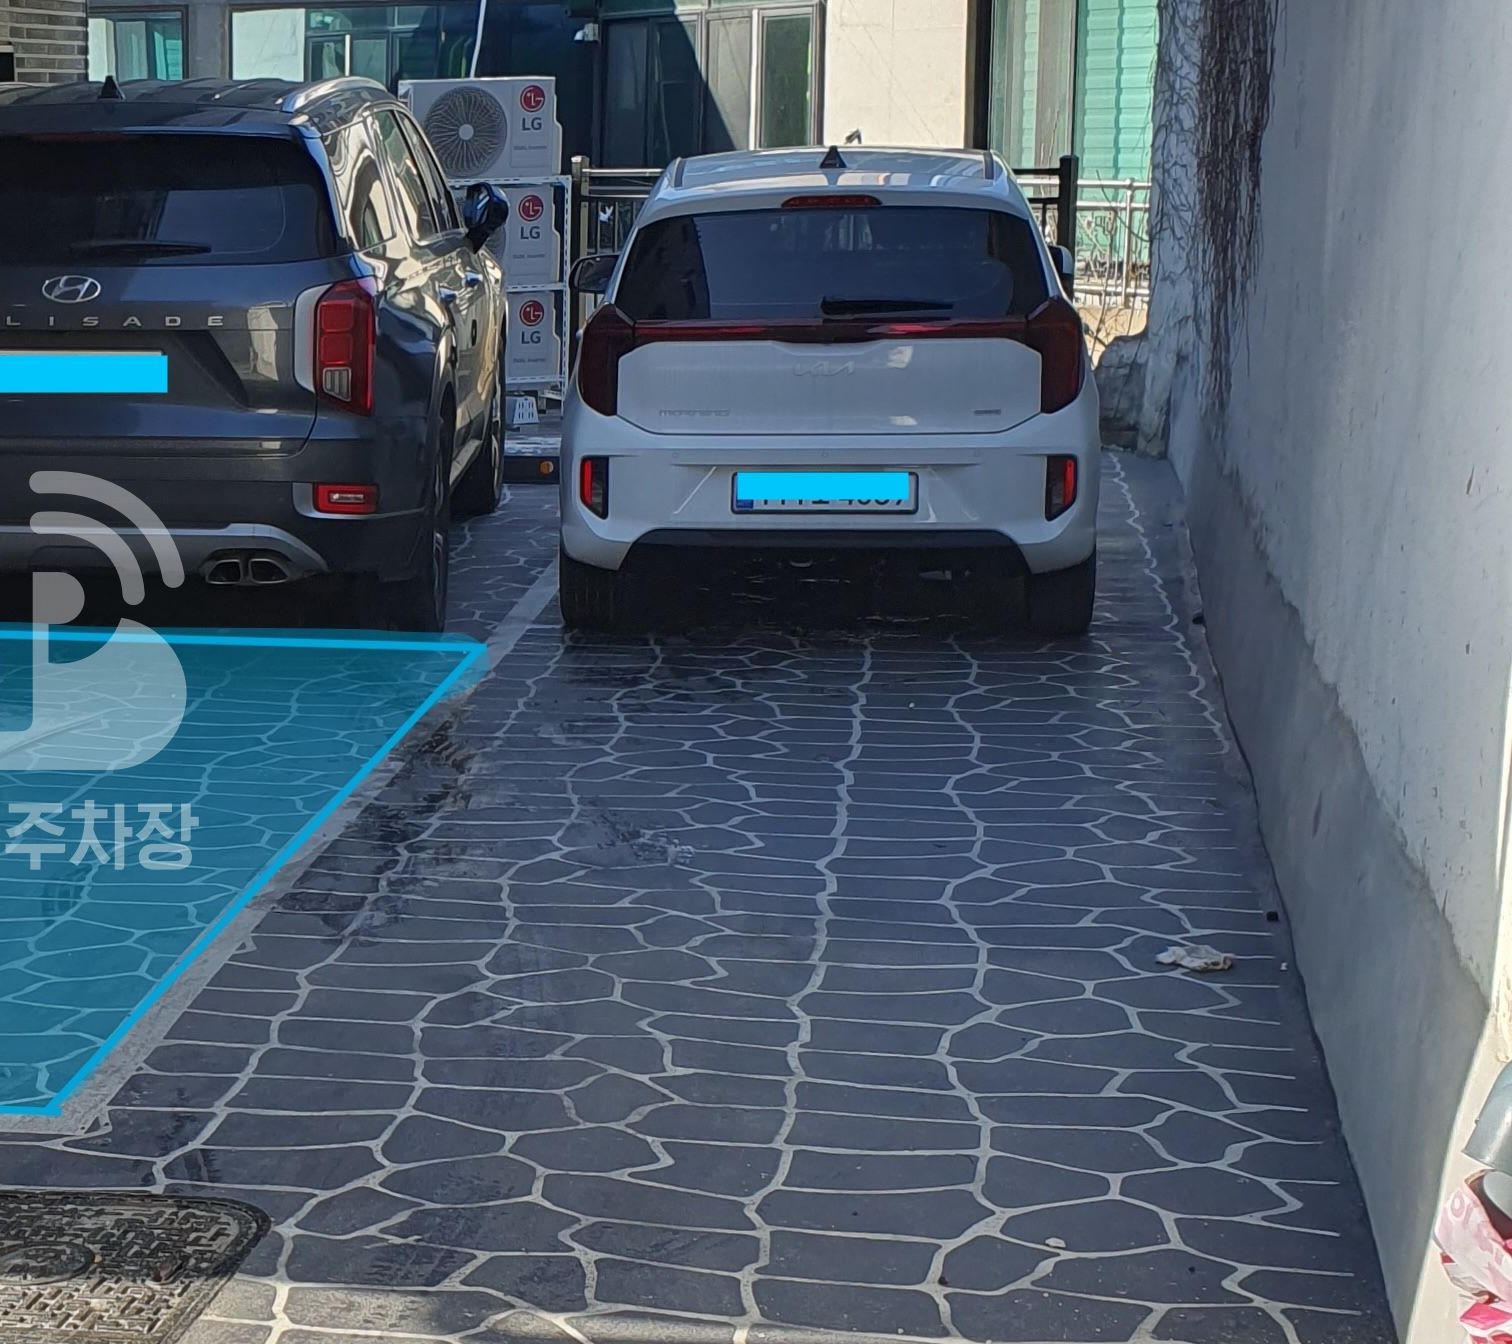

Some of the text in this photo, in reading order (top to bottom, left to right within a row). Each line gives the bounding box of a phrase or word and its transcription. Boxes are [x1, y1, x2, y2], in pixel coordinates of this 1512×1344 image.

[522, 116, 543, 131] LG
[520, 225, 541, 240] LG
[521, 330, 541, 345] LG
